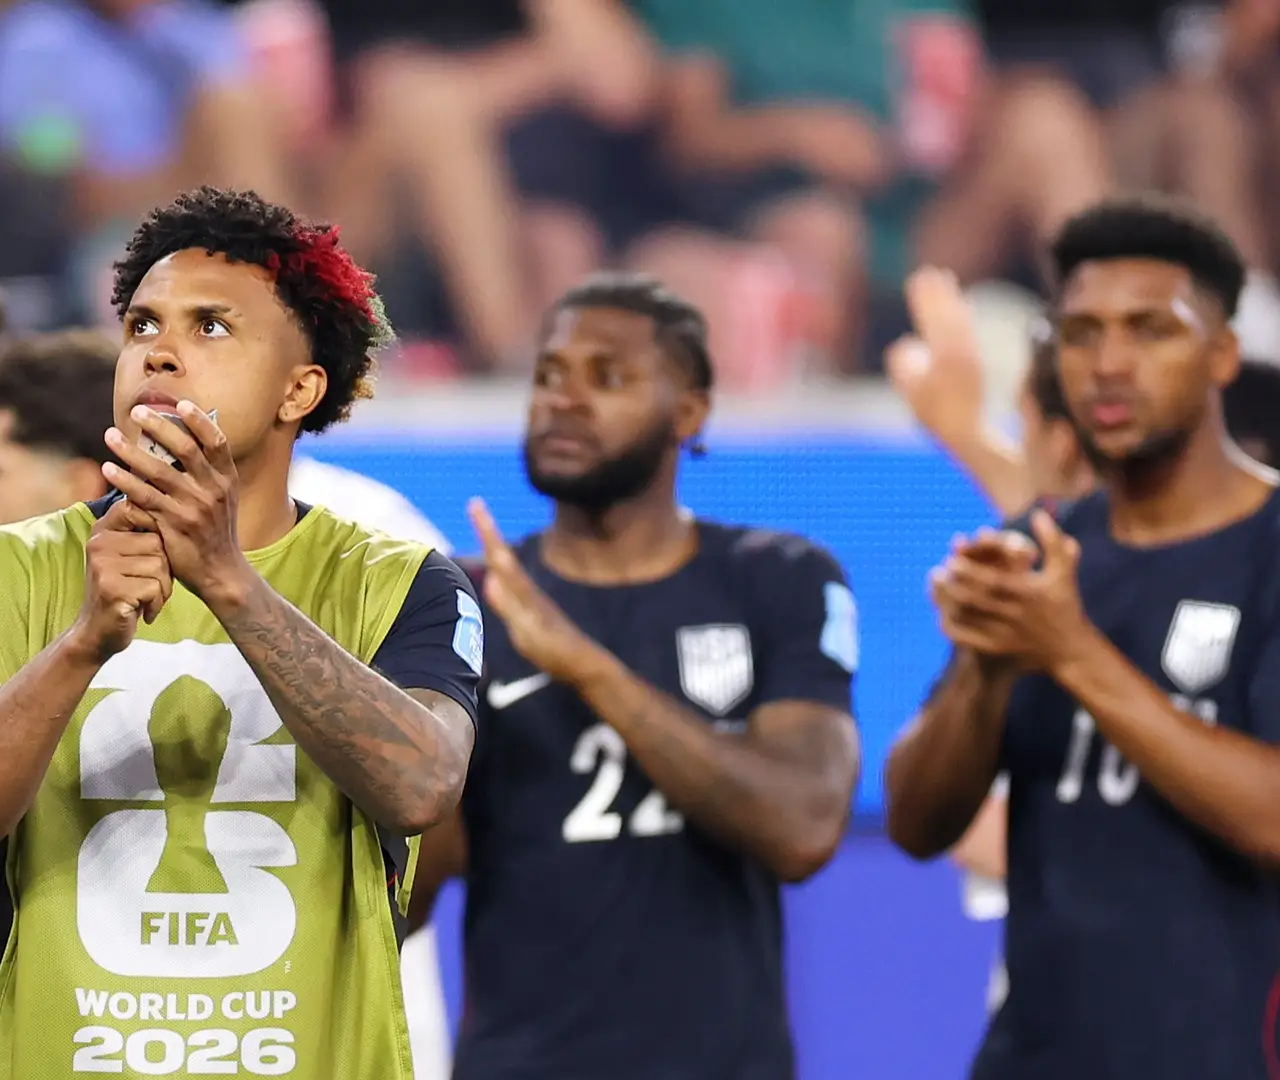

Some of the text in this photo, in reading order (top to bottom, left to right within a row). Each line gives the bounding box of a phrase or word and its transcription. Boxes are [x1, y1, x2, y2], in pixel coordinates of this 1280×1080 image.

[140, 912, 239, 945] FIFA
[75, 987, 298, 1021] WORLD CUP
[72, 1025, 297, 1076] 2026
